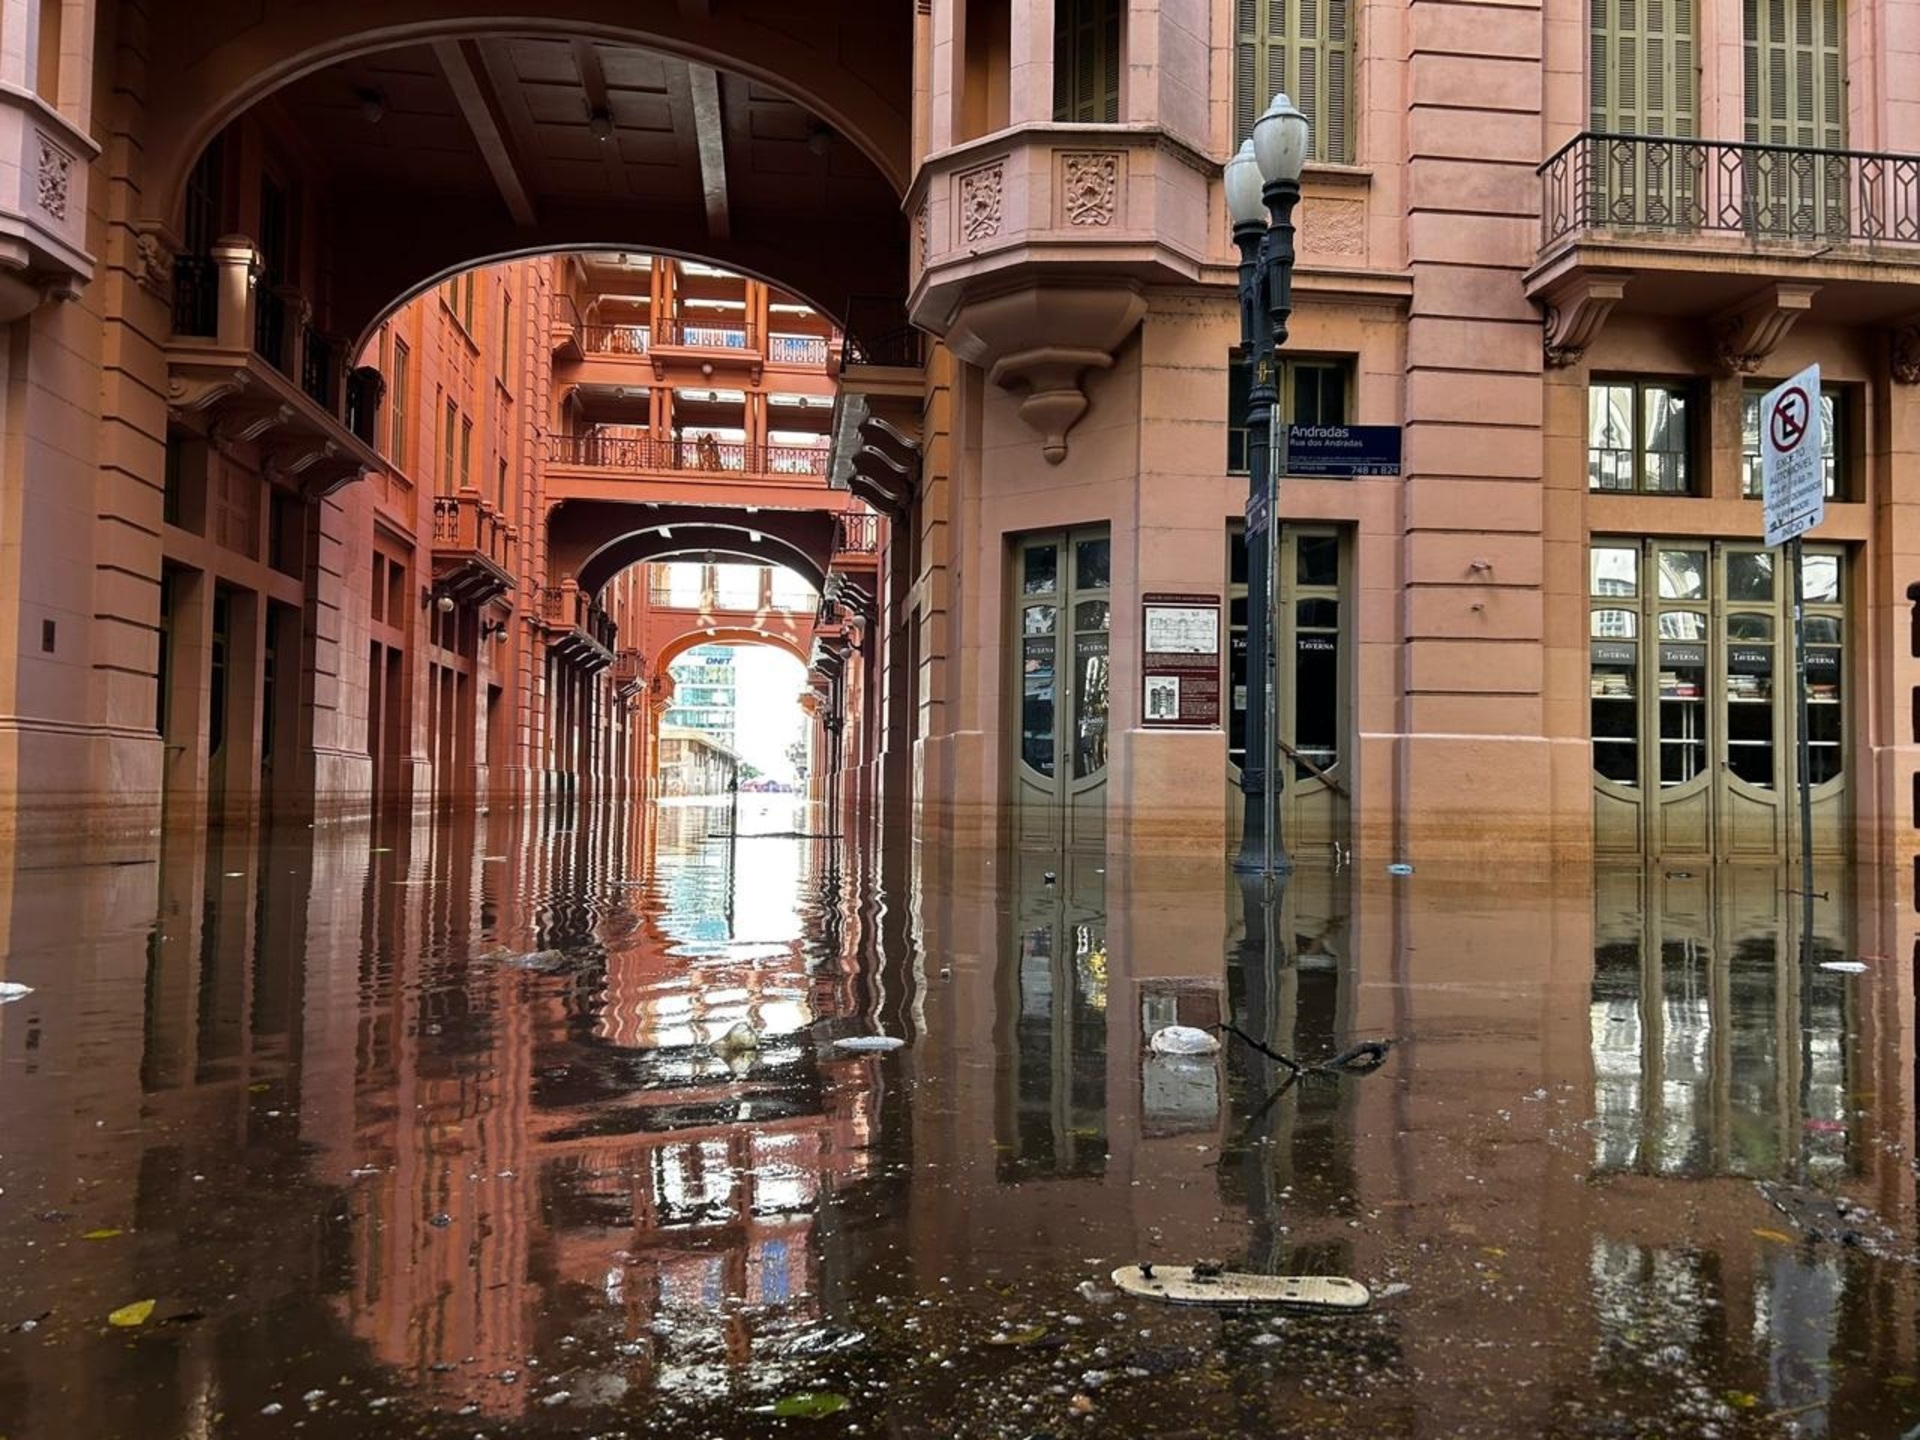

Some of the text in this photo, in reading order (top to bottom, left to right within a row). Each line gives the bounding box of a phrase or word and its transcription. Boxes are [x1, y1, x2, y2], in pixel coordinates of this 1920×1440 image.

[1291, 425, 1349, 438] Andradas
[1290, 439, 1363, 447] Rua dos Andradas
[1351, 466, 1368, 474] 748
[1380, 466, 1399, 474] 824
[1078, 643, 1108, 652] TAVERNA
[1298, 640, 1334, 650] TAVERNA
[1597, 649, 1630, 659] TAVERNA
[1665, 651, 1700, 661] TAVERNA
[1733, 652, 1766, 662] TAVERNA
